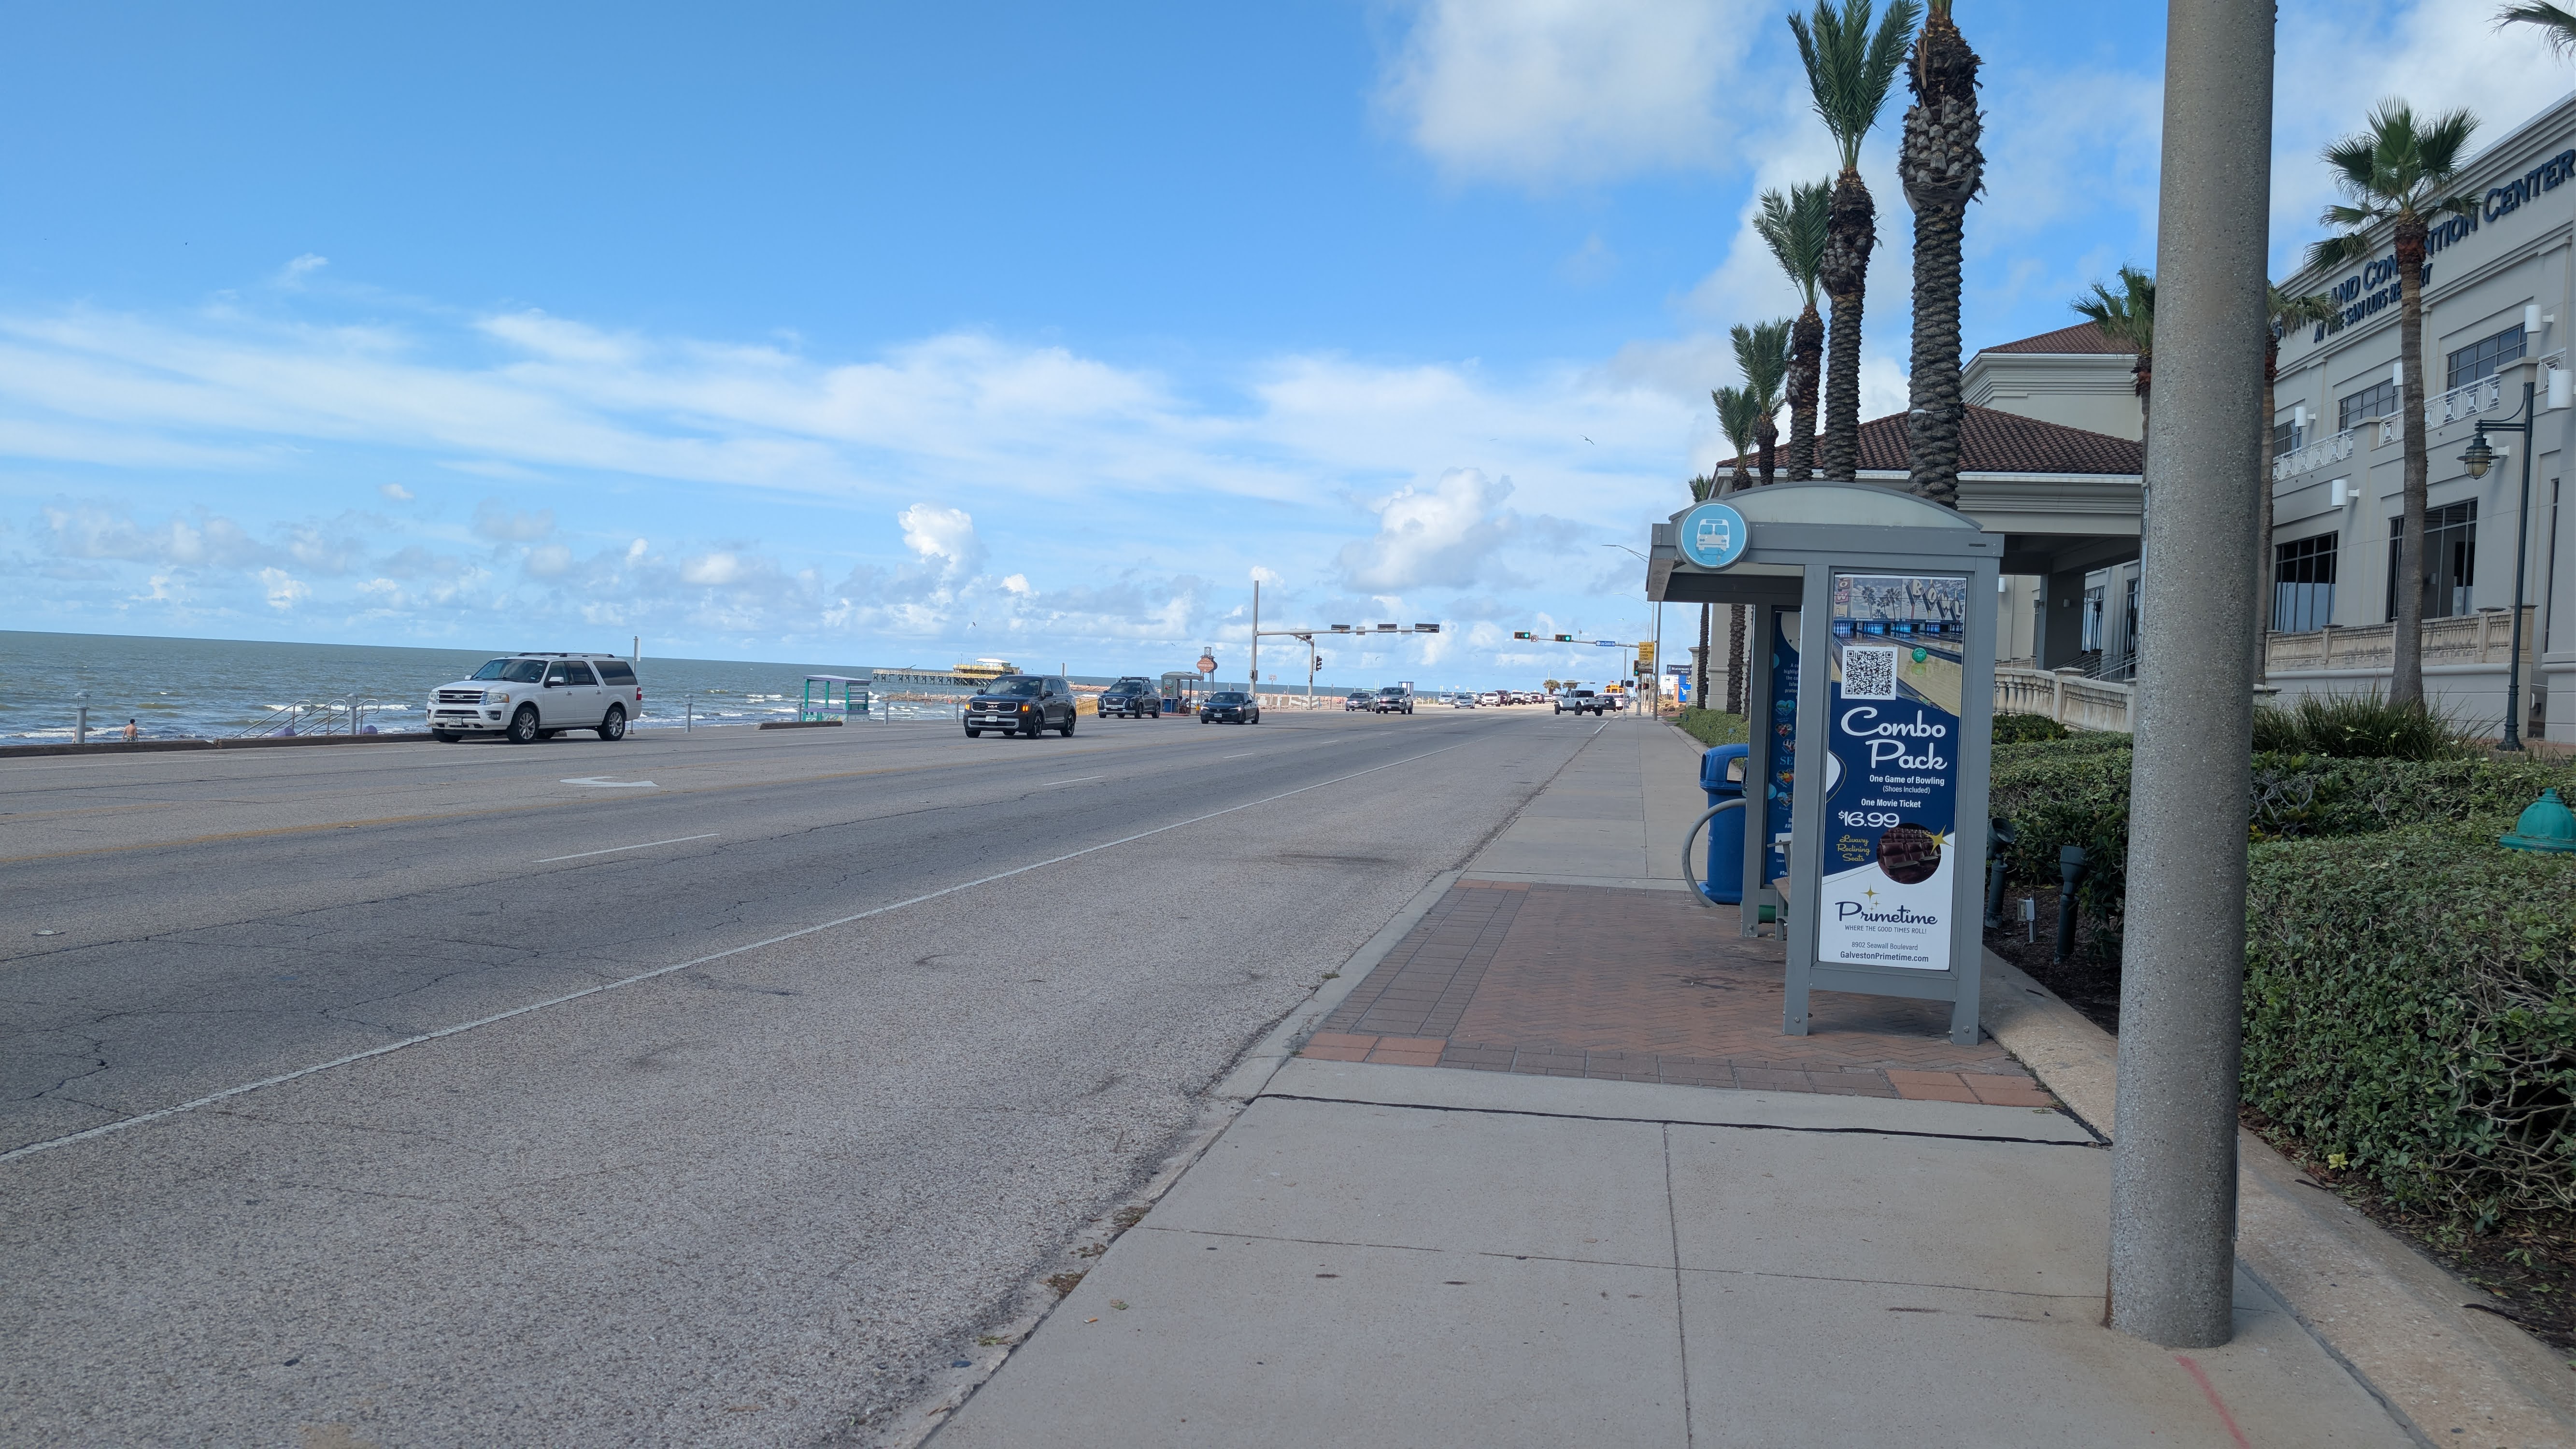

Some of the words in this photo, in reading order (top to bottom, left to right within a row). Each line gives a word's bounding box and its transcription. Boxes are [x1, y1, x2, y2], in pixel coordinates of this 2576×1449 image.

[2363, 207, 2478, 290] CONNTION
[2482, 149, 2576, 223] CENTER
[2313, 322, 2325, 343] AT
[2345, 300, 2365, 326] SAN
[2365, 288, 2389, 315] LUIS
[2389, 263, 2433, 304] RERT
[1912, 579, 1961, 617] BOWL
[1841, 706, 1946, 738] Combo
[1865, 739, 1948, 770] Pack
[1869, 774, 1883, 782] One
[1885, 775, 1906, 783] Game
[1915, 777, 1945, 786] Bowling
[1904, 786, 1931, 795] Included)
[1877, 799, 1898, 807] Movie
[1899, 800, 1921, 808] Ticket
[1838, 810, 1900, 828] $16.99
[1839, 835, 1869, 846] Luxury
[1836, 843, 1871, 856] Reclining
[1842, 853, 1864, 862] Seats
[1835, 901, 1938, 925] Primetime
[1840, 951, 1929, 962] GalvestonPrimetime.com
